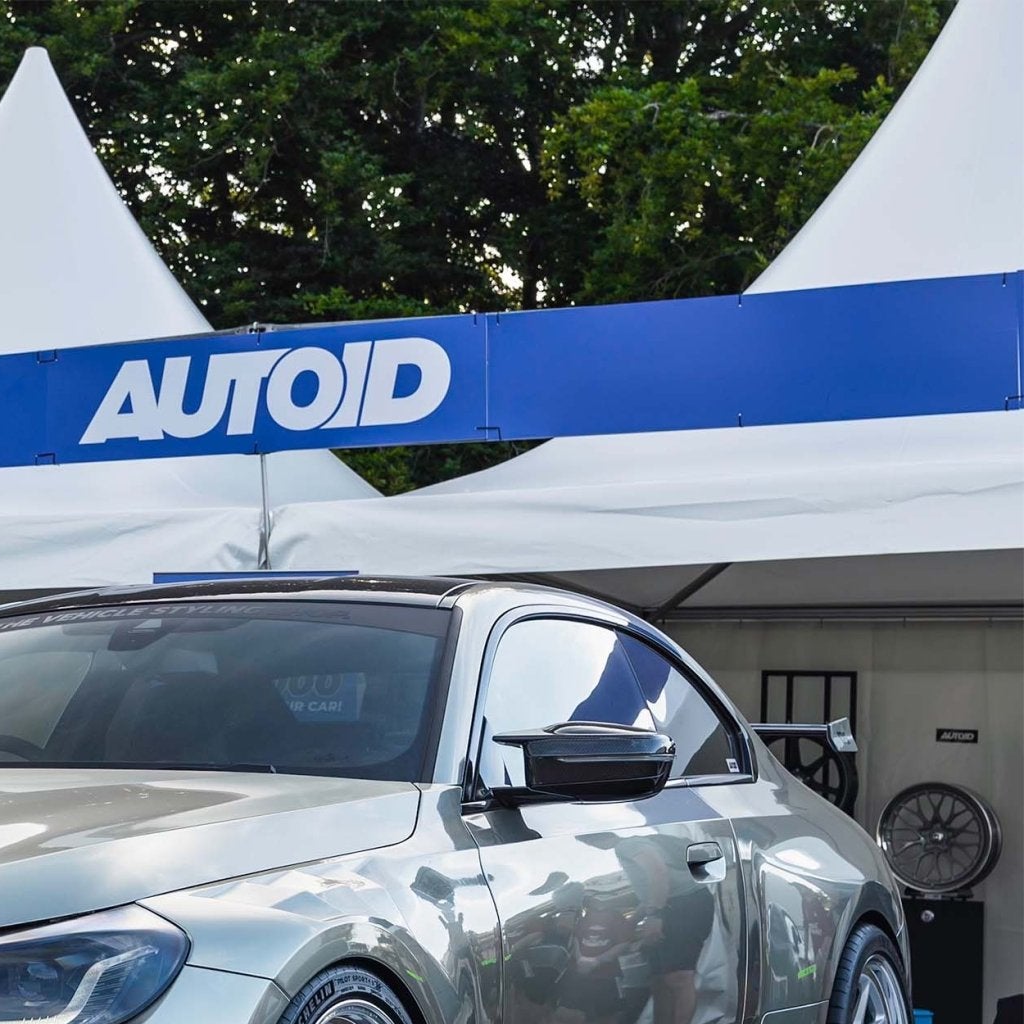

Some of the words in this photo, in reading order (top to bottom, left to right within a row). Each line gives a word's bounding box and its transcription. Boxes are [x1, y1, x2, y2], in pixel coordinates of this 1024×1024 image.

[78, 337, 451, 444] AUTOID
[42, 607, 150, 624] VEHICLE
[153, 605, 265, 616] STYLING
[308, 701, 342, 712] CAR!
